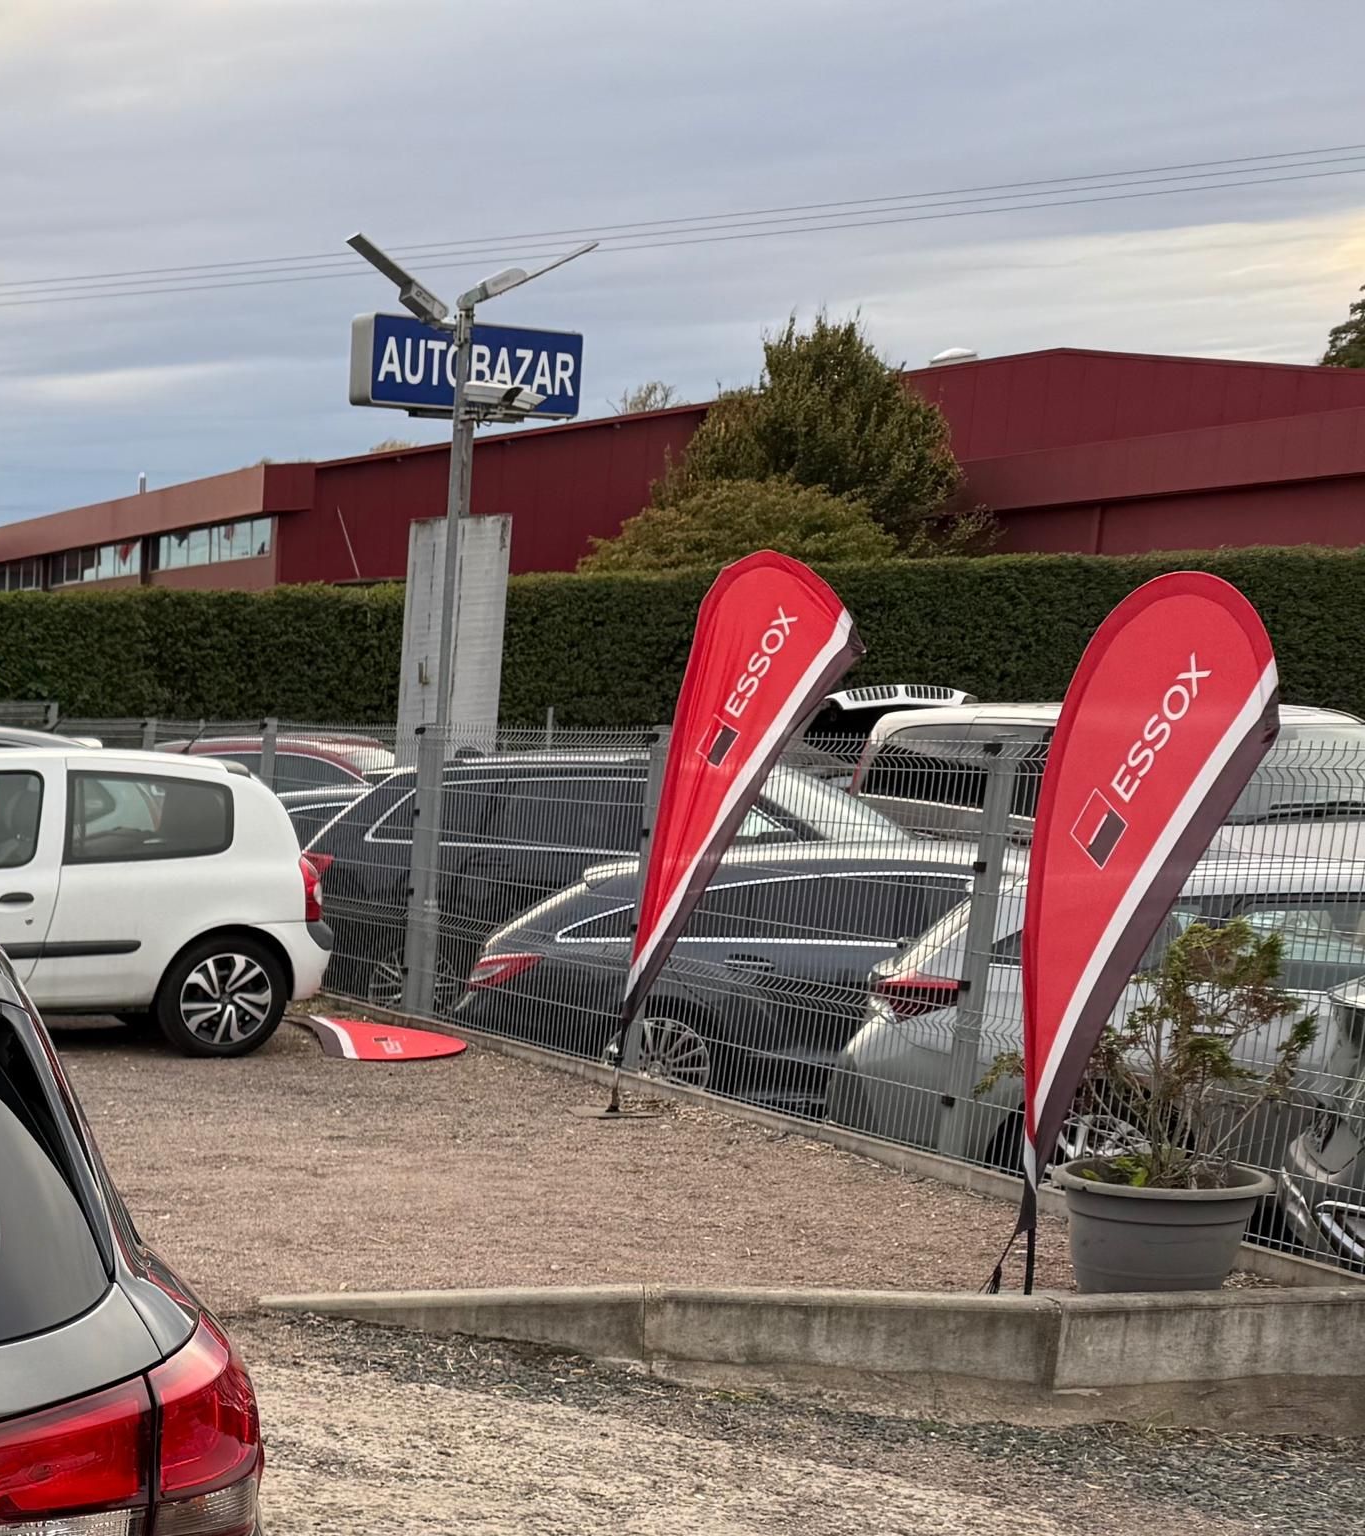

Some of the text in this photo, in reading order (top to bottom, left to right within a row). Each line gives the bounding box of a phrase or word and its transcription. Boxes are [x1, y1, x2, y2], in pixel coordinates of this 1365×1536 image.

[377, 336, 575, 396] AUTOBAZAR
[725, 605, 798, 718] ESSOX
[1110, 652, 1212, 803] ESSOX
